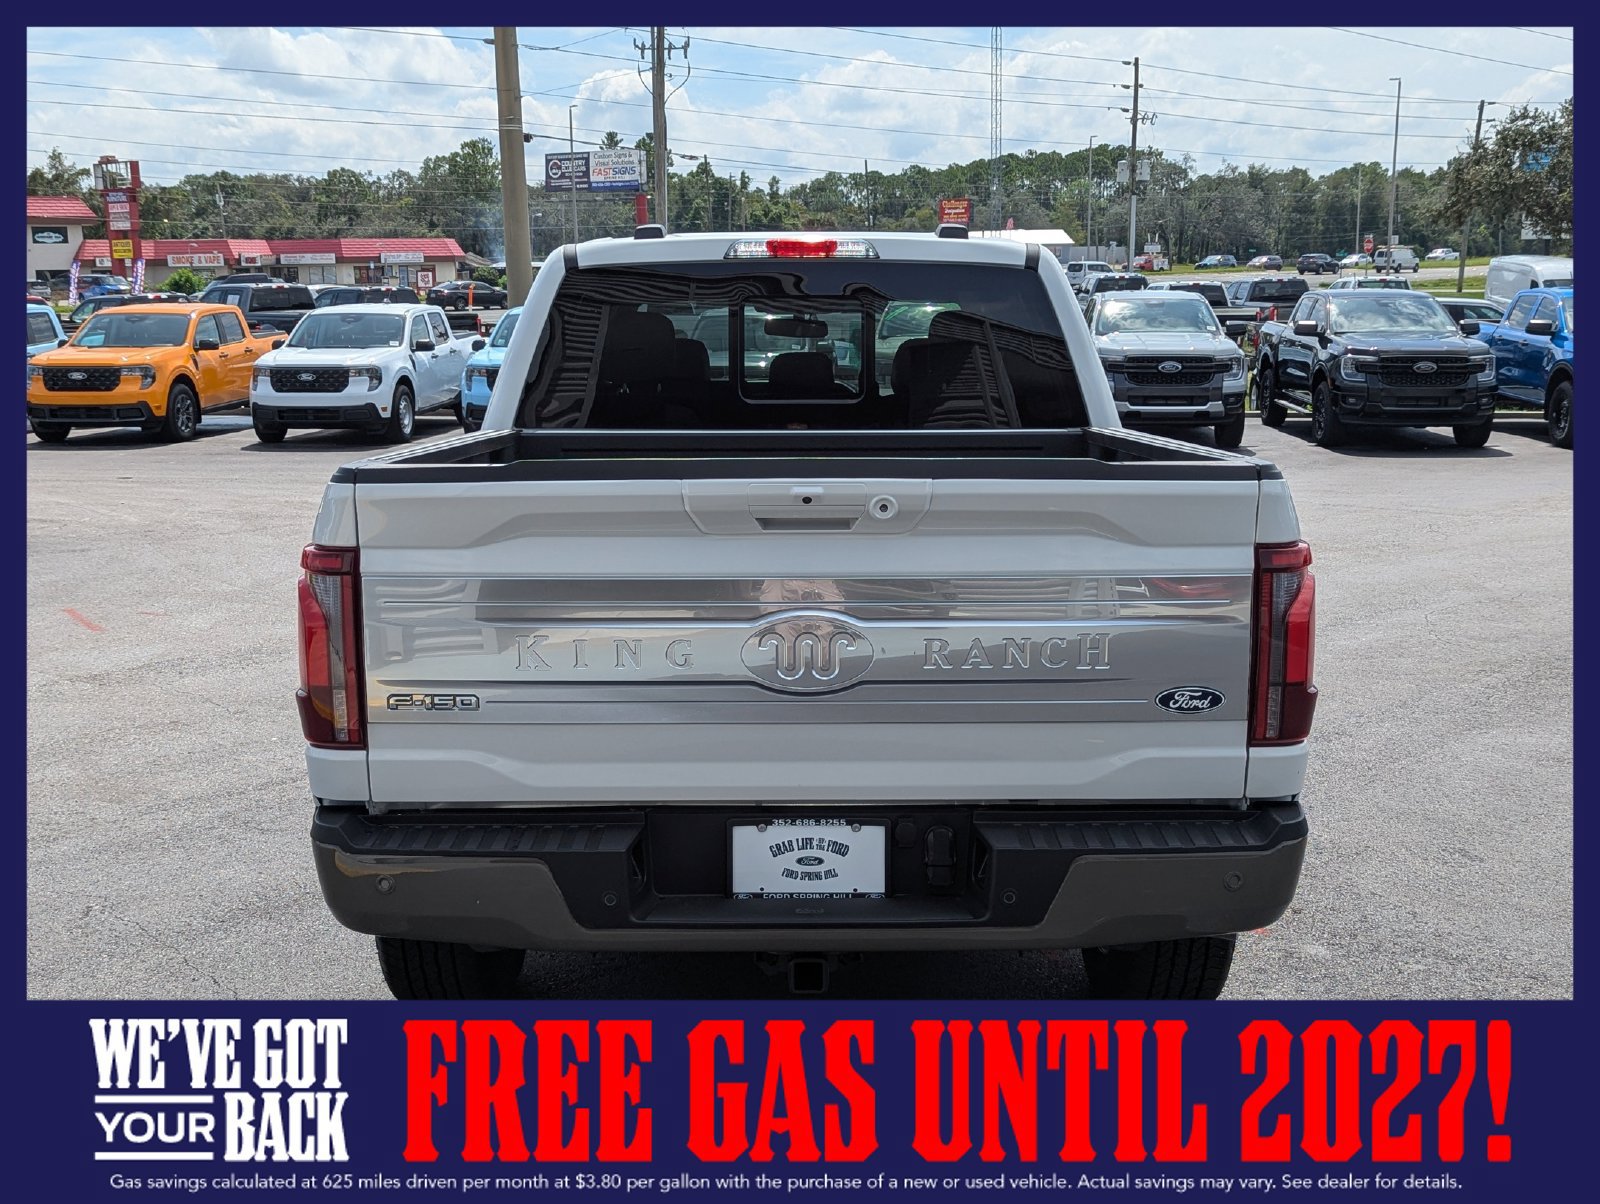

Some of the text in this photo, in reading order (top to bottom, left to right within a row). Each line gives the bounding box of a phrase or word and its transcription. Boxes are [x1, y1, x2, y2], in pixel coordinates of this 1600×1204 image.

[614, 151, 627, 159] Signs
[592, 166, 636, 176] FASTSIGNS
[171, 255, 195, 265] SMOKE
[204, 255, 221, 264] VAPE
[515, 632, 1111, 672] KING RANCH
[386, 693, 480, 711] F-150
[1164, 688, 1216, 712] Ford
[769, 837, 814, 857] GRAB LIFE
[826, 840, 850, 857] FORD
[798, 856, 822, 866] Ford
[781, 868, 839, 881] FORD SPRING HILL
